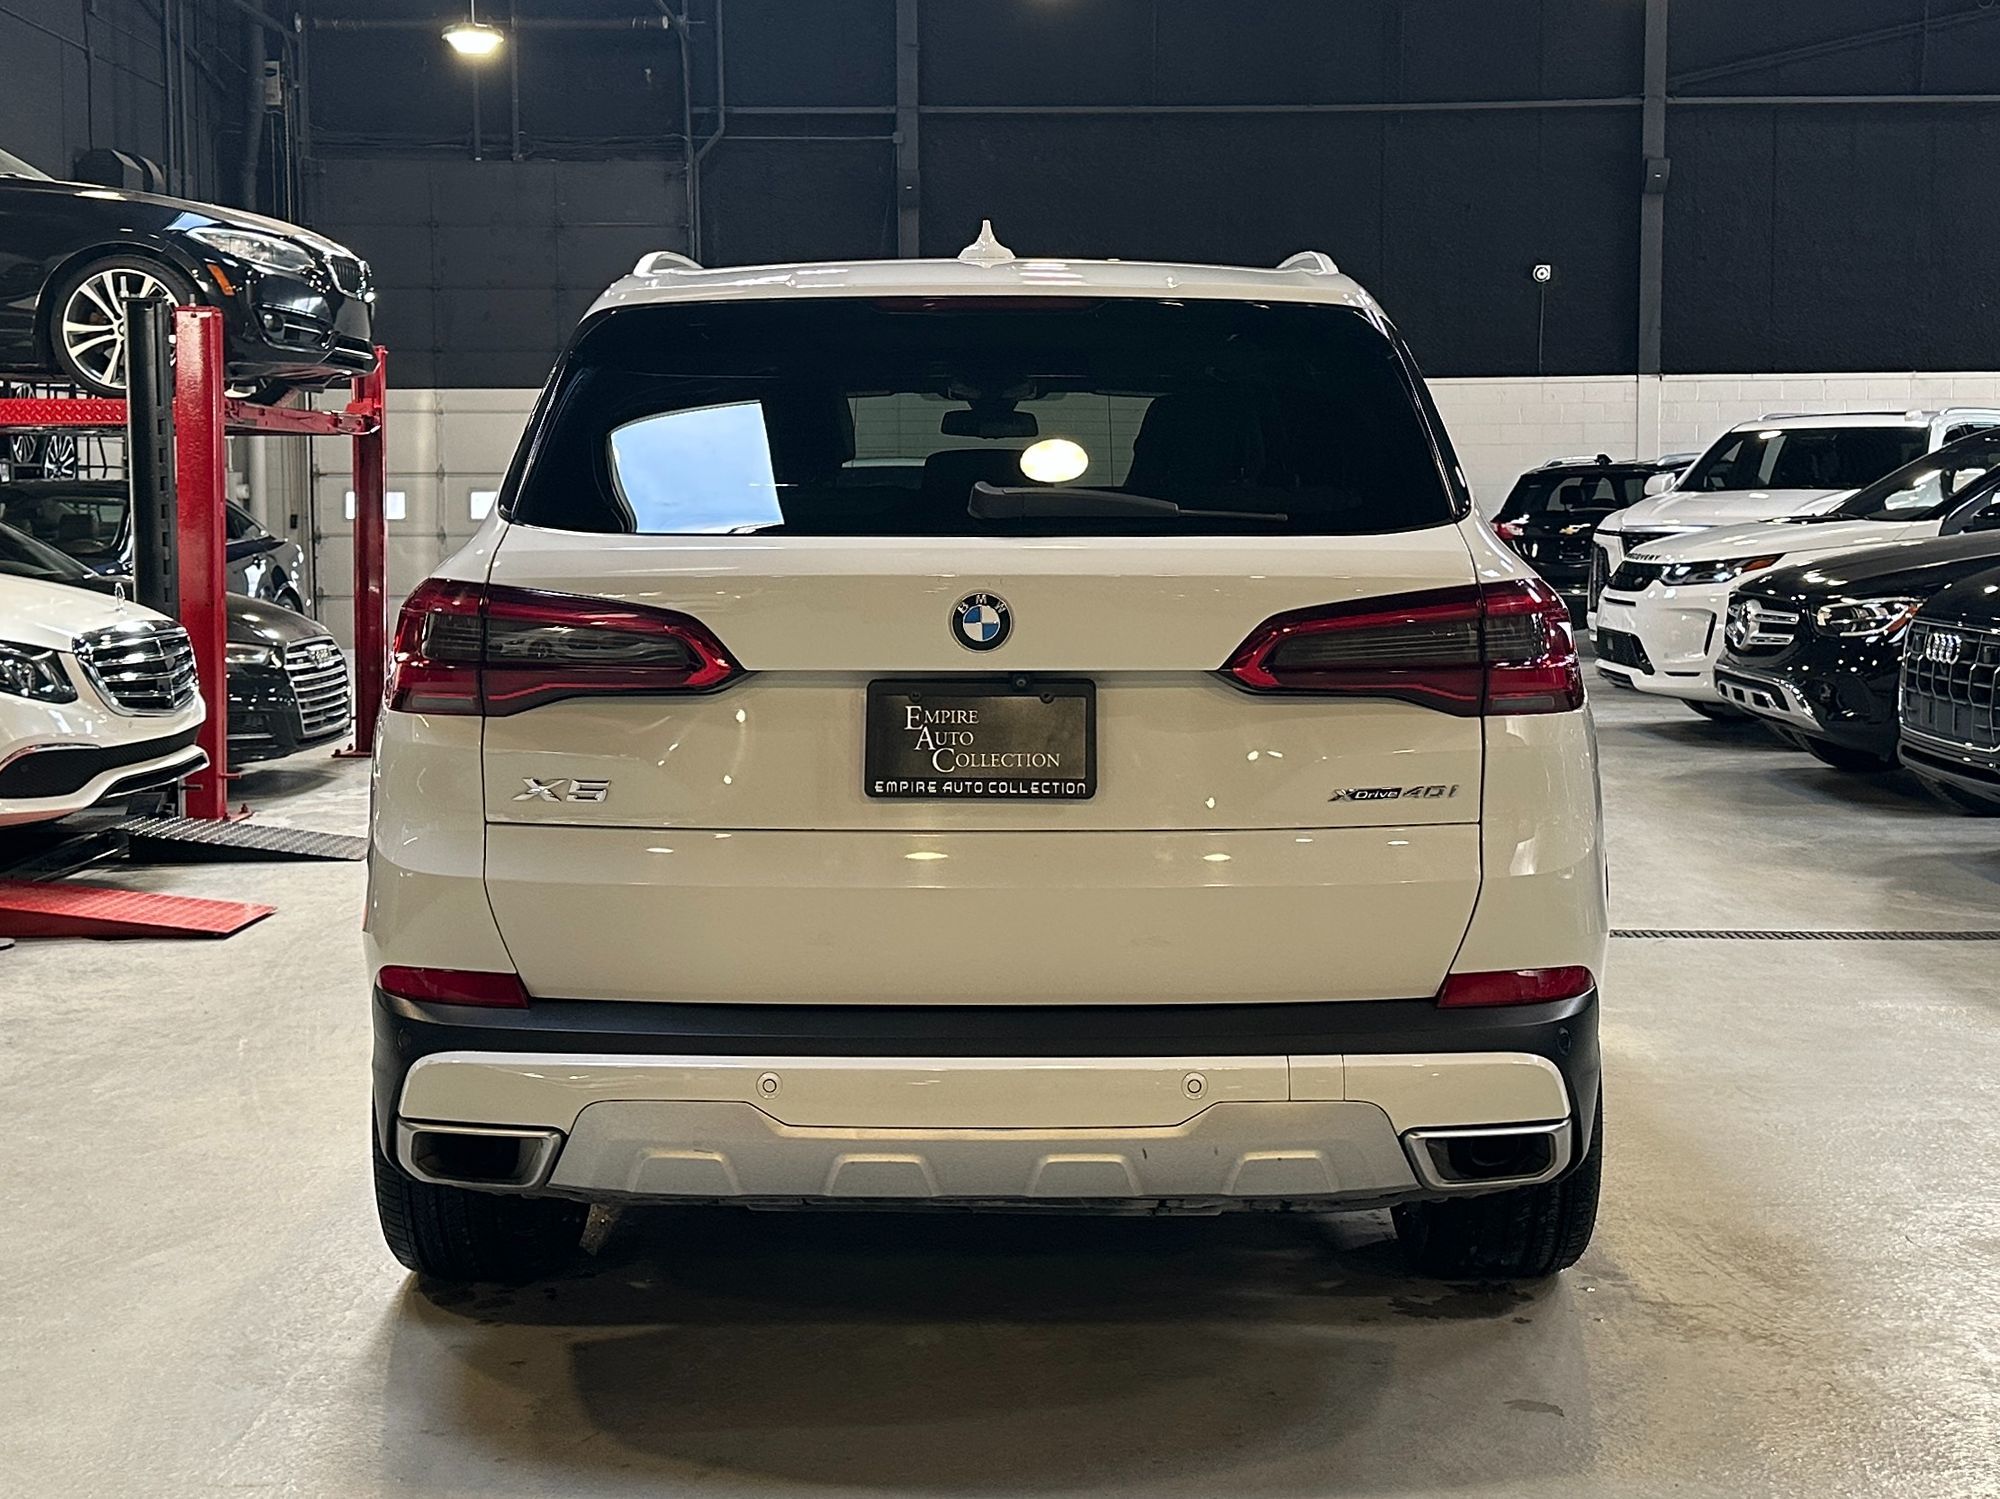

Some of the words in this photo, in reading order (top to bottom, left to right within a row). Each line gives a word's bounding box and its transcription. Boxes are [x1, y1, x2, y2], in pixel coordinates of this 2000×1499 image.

[957, 594, 1006, 614] BMW
[904, 705, 979, 730] EMPIRE
[914, 726, 974, 750] AUTO
[932, 748, 1060, 773] COLLECTION
[512, 777, 611, 803] X5
[874, 780, 937, 794] EMPIRE
[942, 781, 983, 794] AUTO
[988, 781, 1086, 795] COLLECTION
